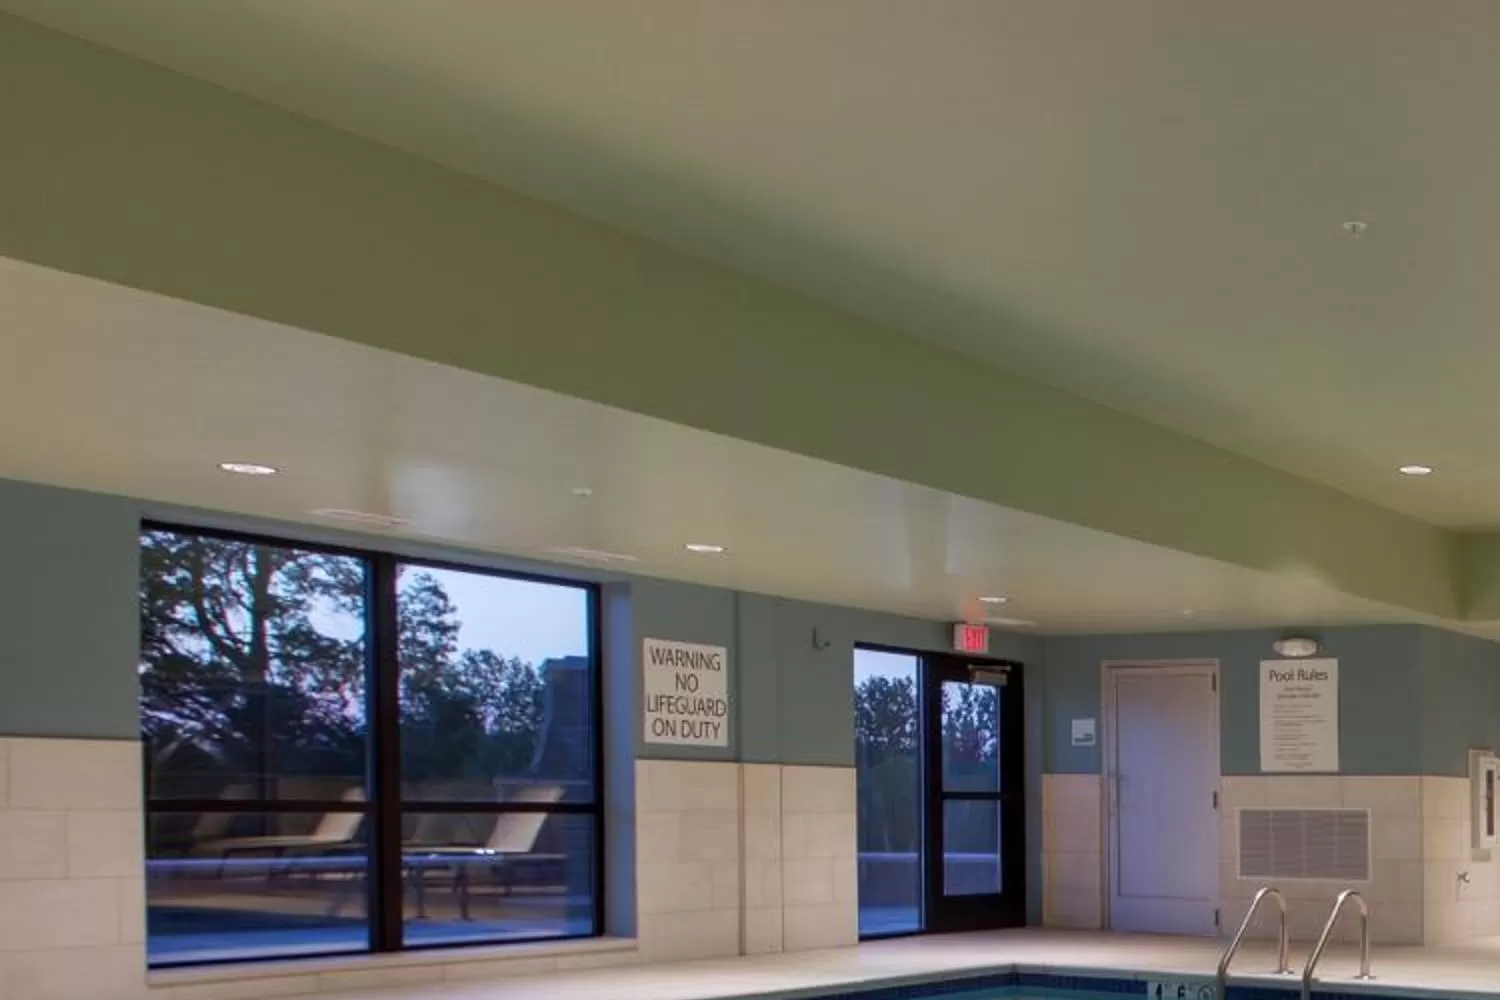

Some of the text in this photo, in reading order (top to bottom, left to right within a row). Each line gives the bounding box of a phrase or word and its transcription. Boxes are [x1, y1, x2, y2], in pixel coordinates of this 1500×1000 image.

[649, 646, 721, 672] WARNING
[675, 673, 699, 693] NO
[1269, 668, 1329, 682] Pool Rules
[647, 694, 727, 717] LIFEGUARD
[652, 718, 720, 740] ON DUTY
